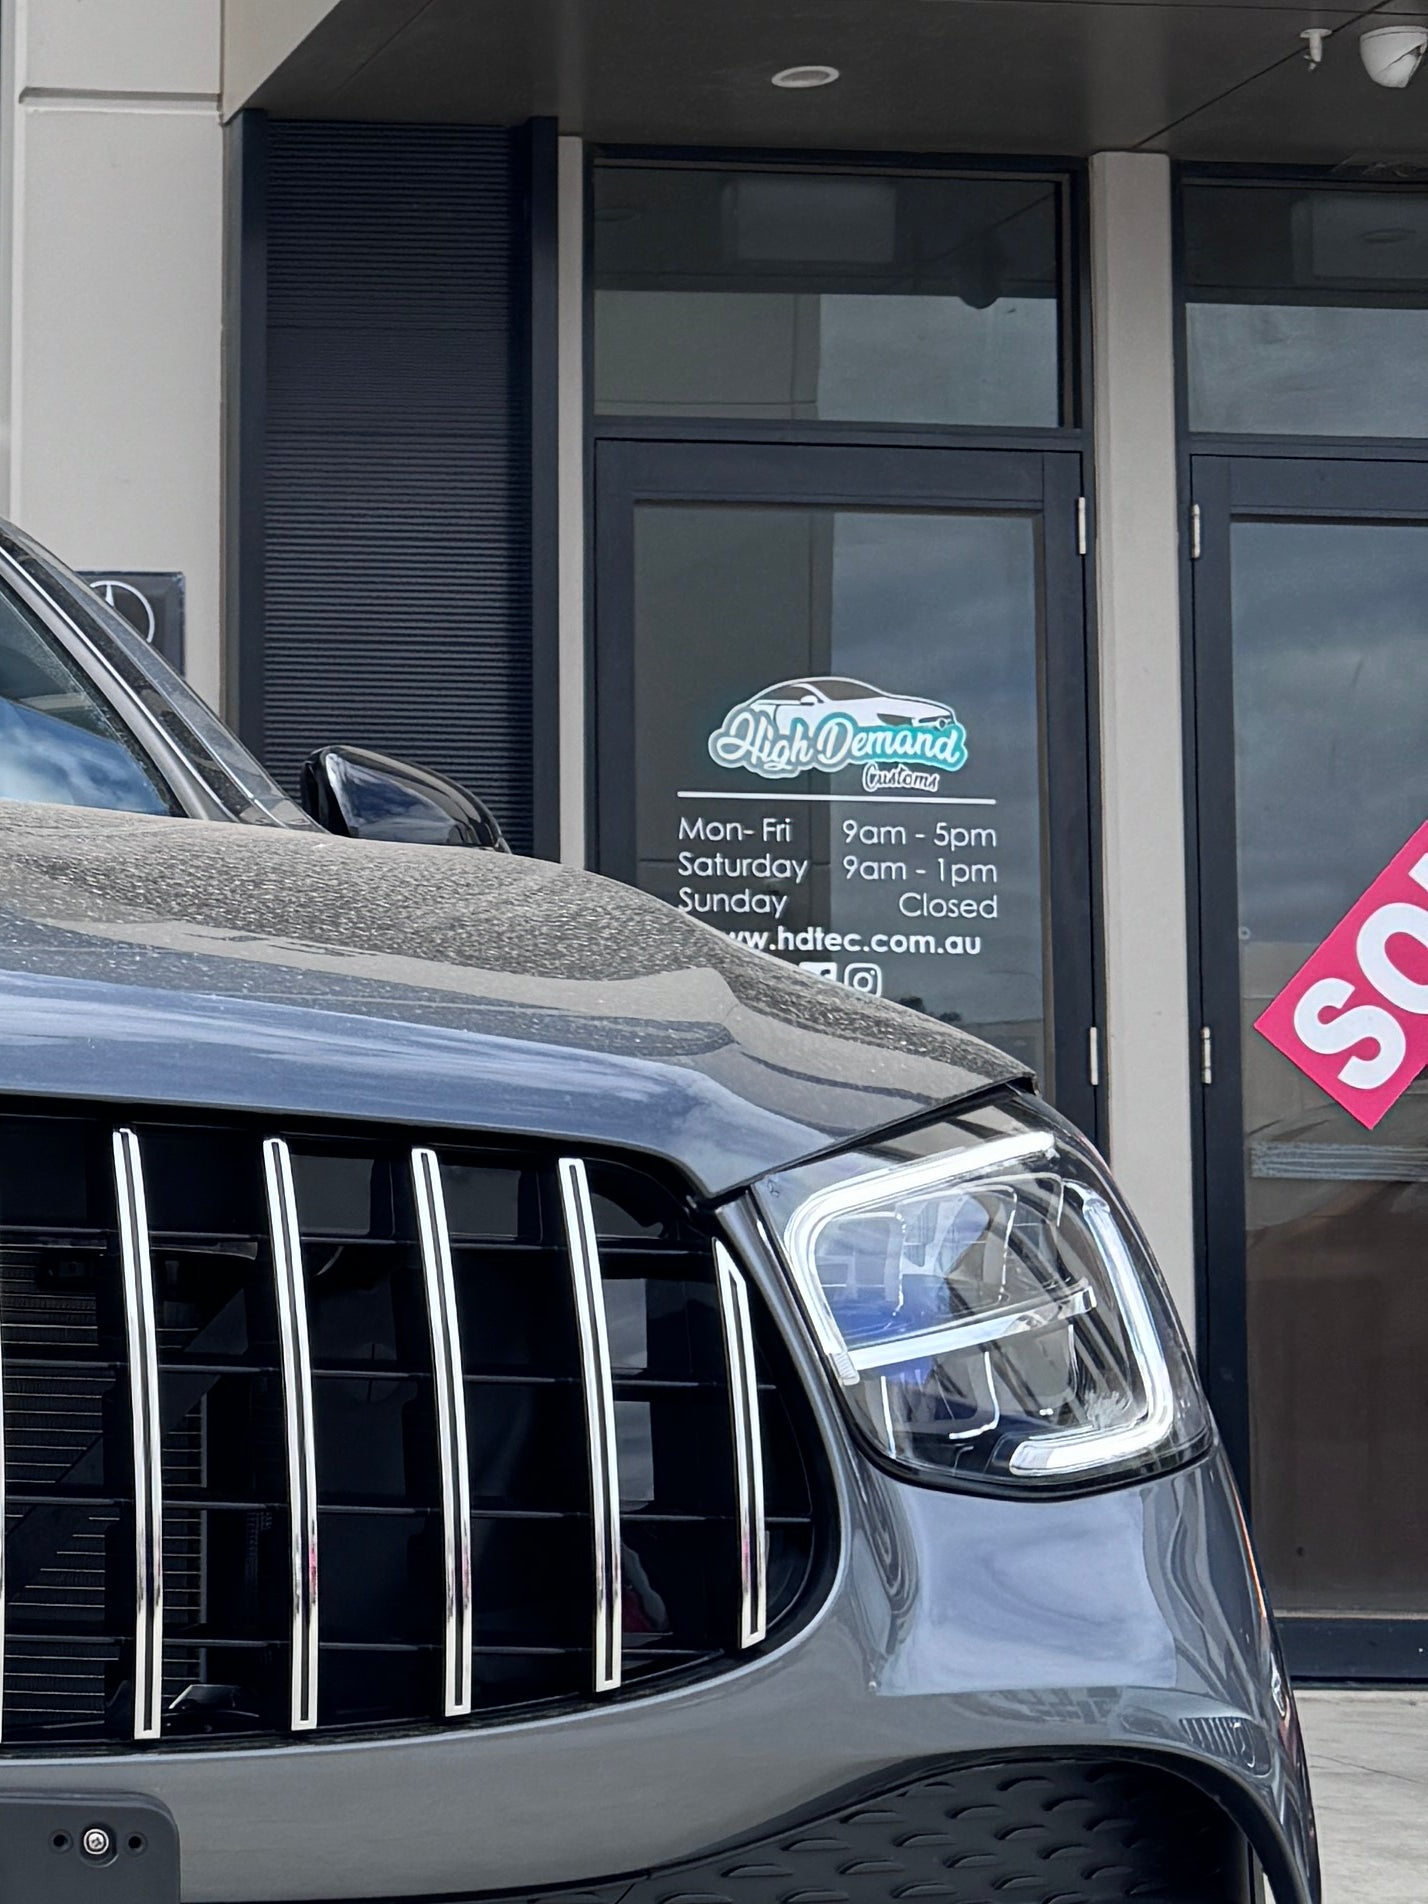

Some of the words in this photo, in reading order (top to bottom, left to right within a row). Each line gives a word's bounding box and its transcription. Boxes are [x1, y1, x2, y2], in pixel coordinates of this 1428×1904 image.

[716, 711, 813, 771] High
[816, 717, 961, 763] Demand
[863, 762, 940, 792] Customs
[678, 817, 755, 842] Mon-
[762, 817, 792, 842] Fri
[842, 820, 907, 845] 9am
[933, 821, 998, 852] 5pm
[677, 851, 808, 884] Saturday
[842, 856, 907, 881] 9am
[937, 857, 999, 884] 1pm
[678, 887, 787, 919] Sunday
[898, 892, 999, 918] Closed
[1294, 853, 1428, 1089] SO
